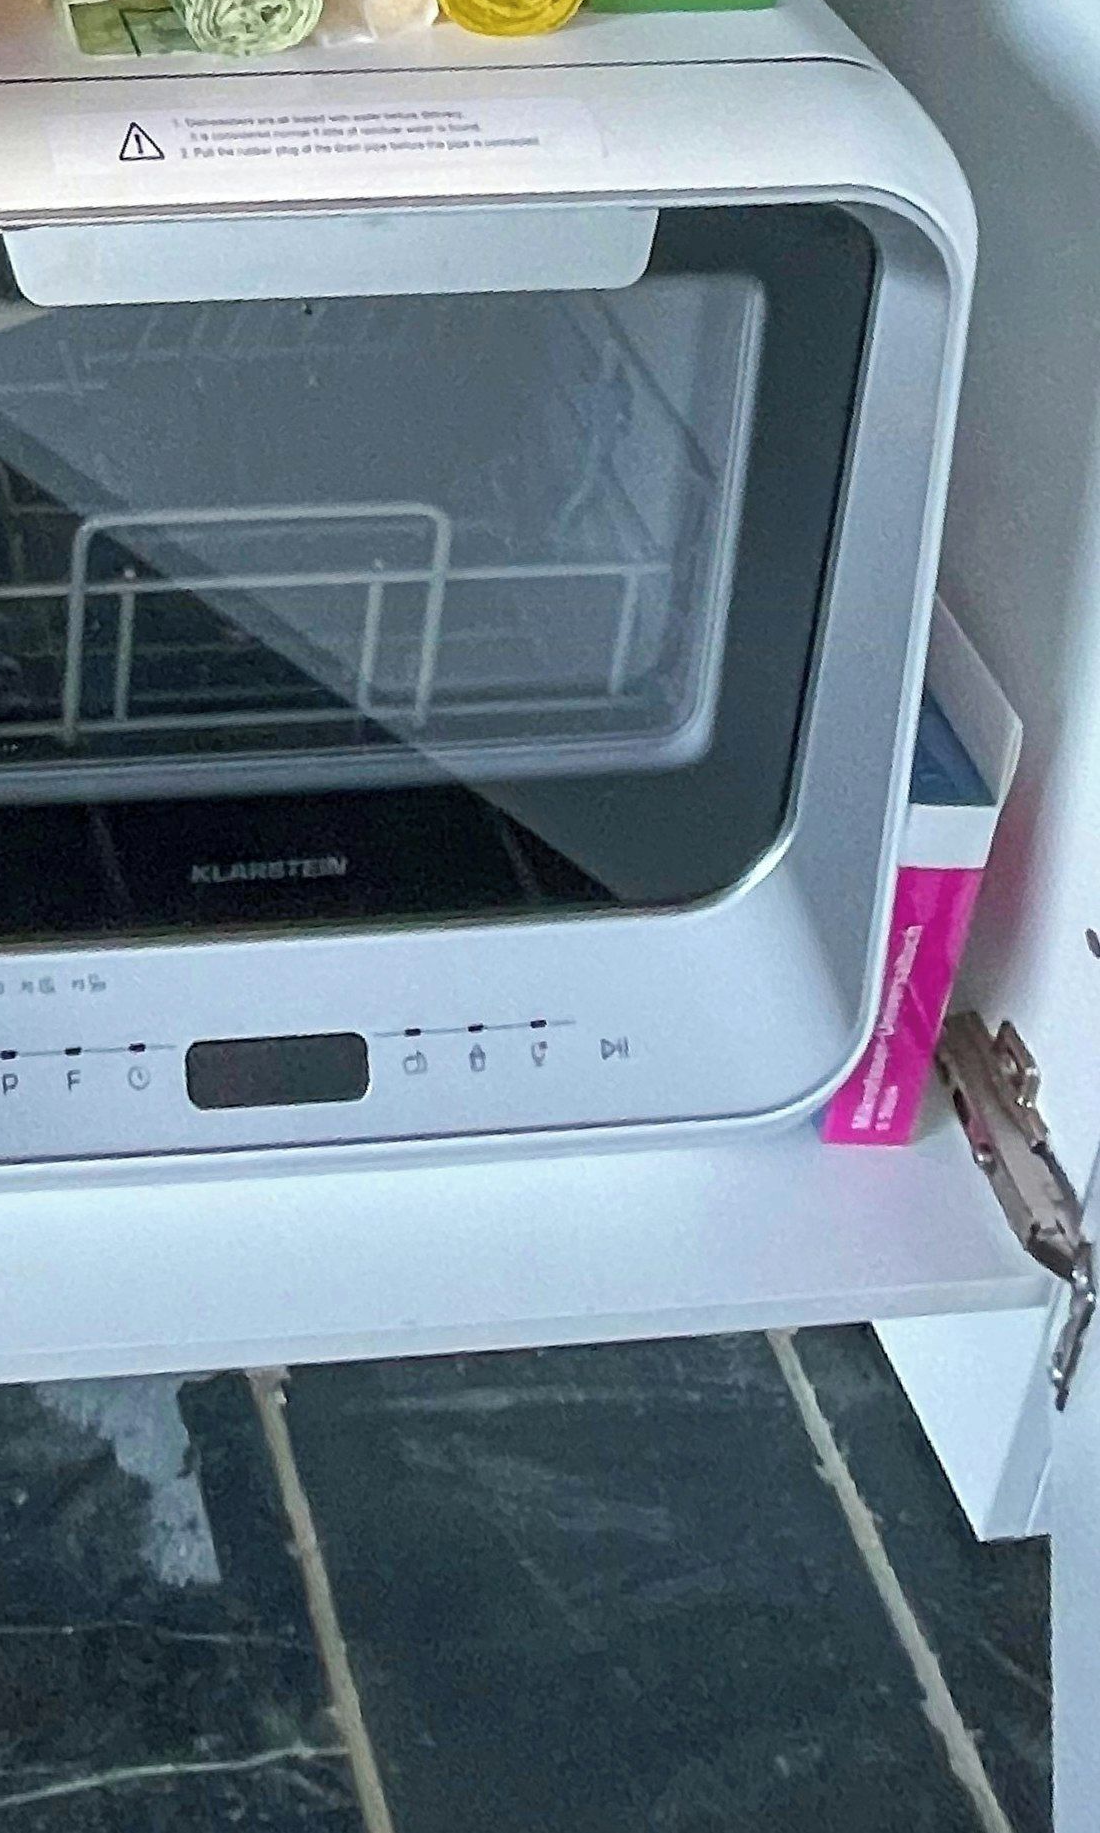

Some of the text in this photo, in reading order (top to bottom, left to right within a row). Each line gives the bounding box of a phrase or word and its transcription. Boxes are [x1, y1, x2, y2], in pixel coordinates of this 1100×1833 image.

[191, 857, 348, 884] KLARSTEIN
[2, 1073, 19, 1096] P
[67, 1069, 82, 1092] F
